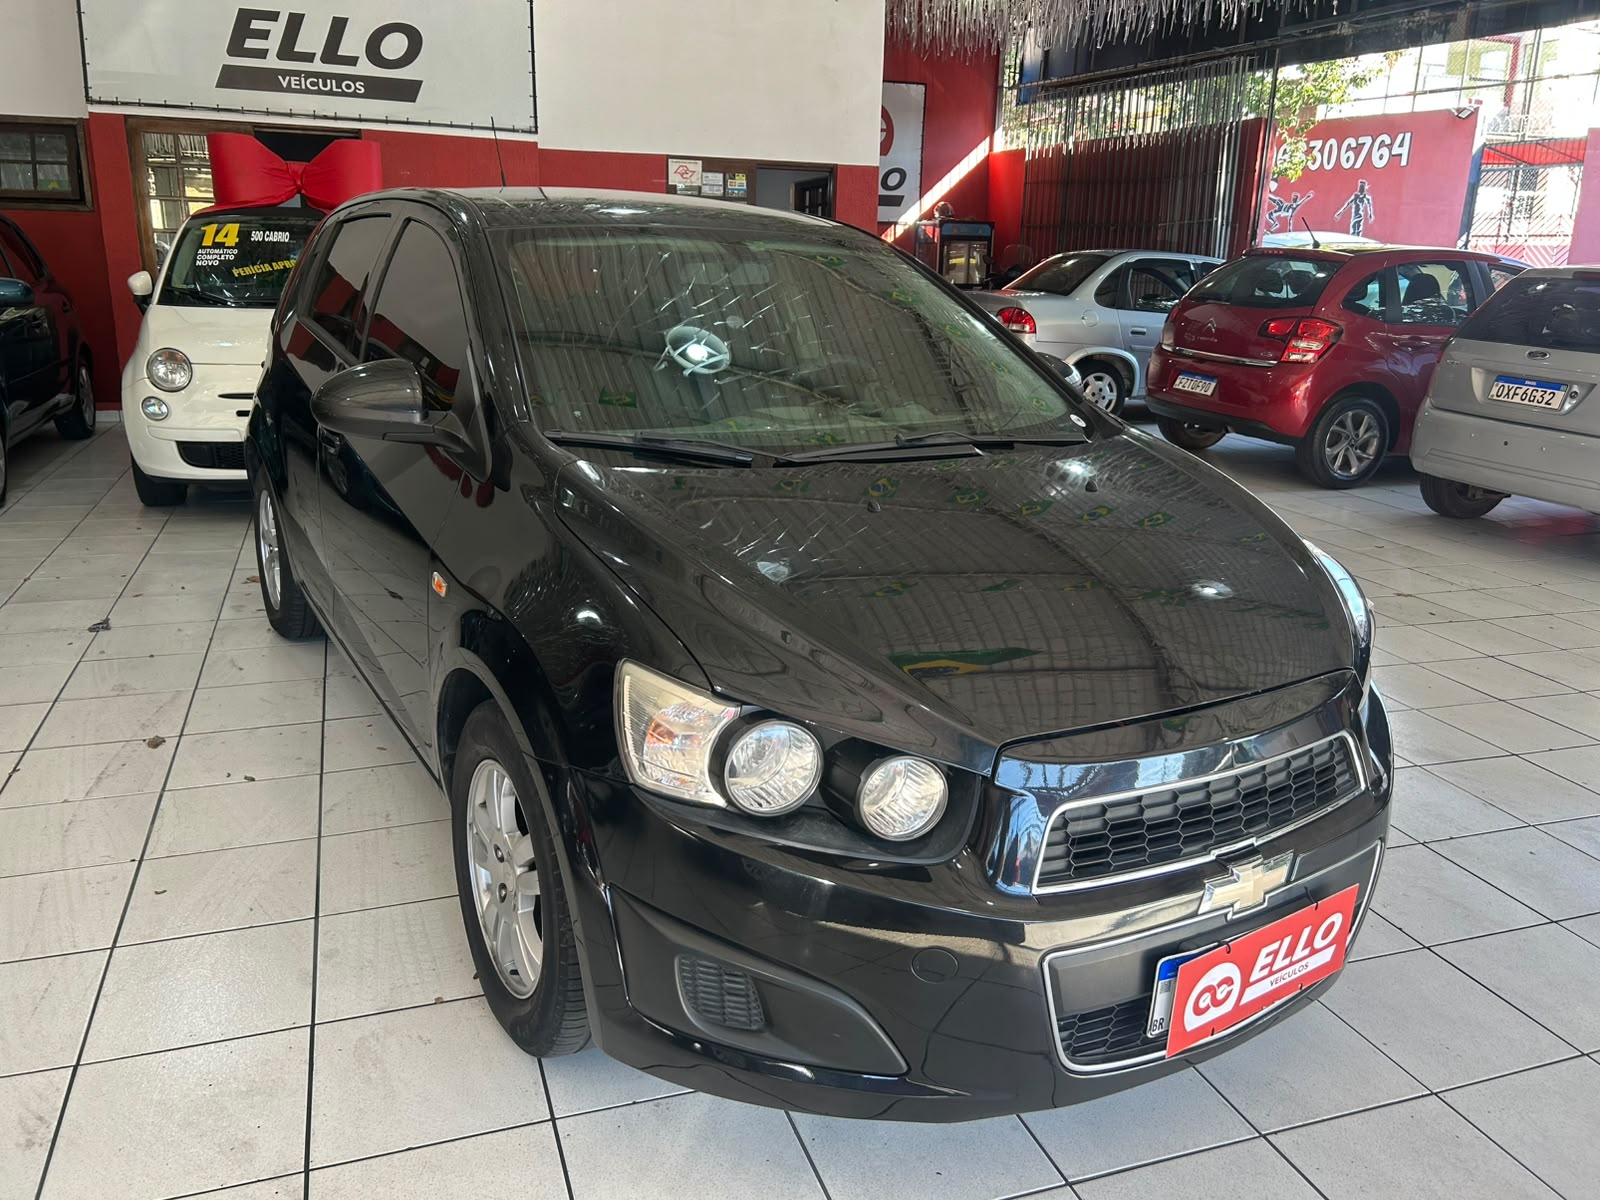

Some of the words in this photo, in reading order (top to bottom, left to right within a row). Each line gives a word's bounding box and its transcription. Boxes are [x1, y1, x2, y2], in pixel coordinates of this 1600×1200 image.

[226, 8, 423, 69] ELLO
[278, 74, 365, 93] VEÍCULOS
[201, 223, 240, 246] 14
[250, 231, 264, 241] 500
[264, 231, 290, 242] CABRIO
[232, 263, 273, 277] PERÍCIA
[1495, 384, 1556, 405] OXF6G32
[1249, 912, 1343, 982] ELLO
[1269, 961, 1310, 987] VEÍCULOS
[1152, 1017, 1165, 1032] BR
